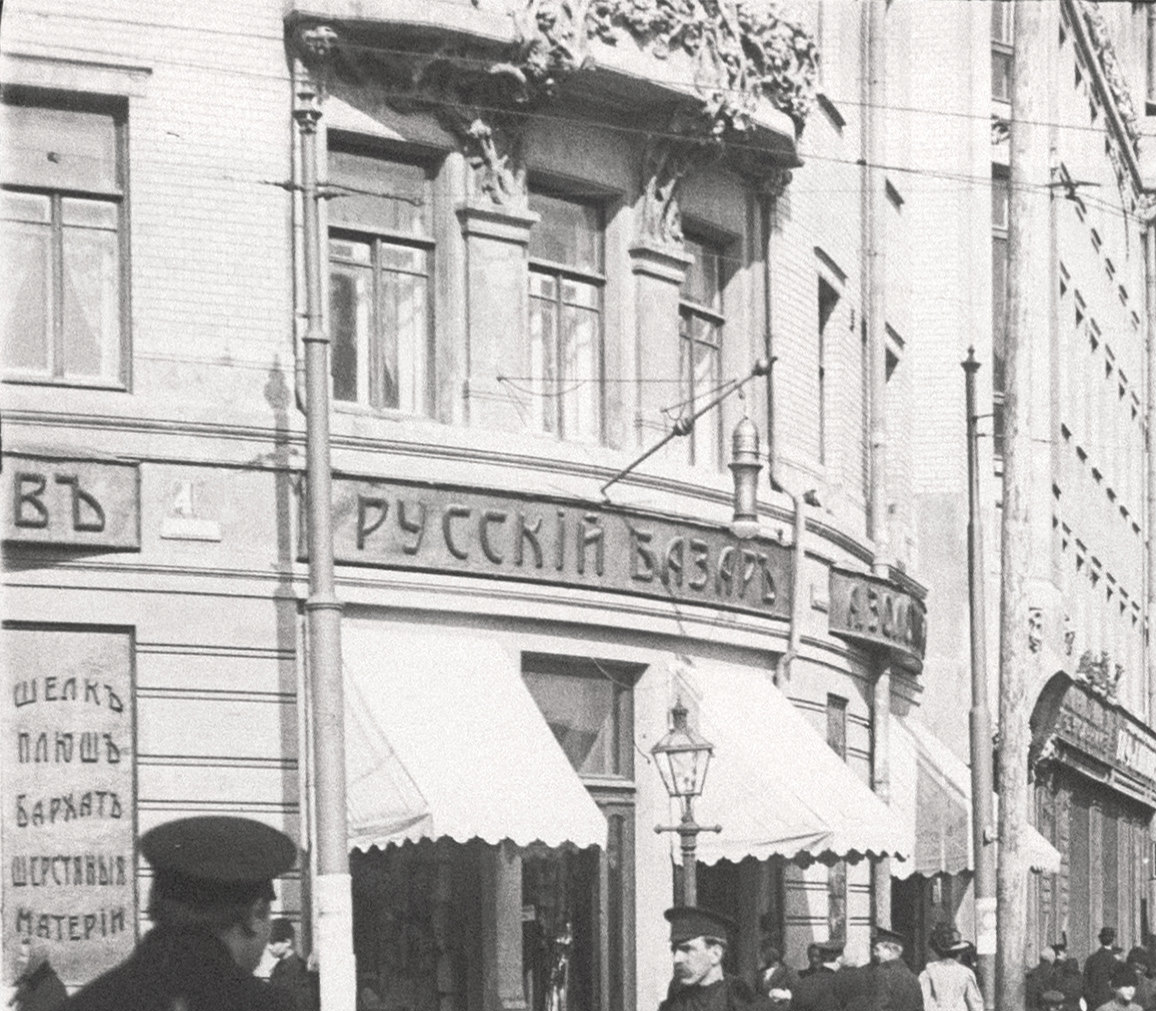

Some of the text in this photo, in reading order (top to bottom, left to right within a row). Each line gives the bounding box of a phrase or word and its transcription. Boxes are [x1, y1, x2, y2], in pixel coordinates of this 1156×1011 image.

[355, 495, 776, 605] РУССКІЙ БАЗАРЪ
[14, 676, 124, 713] ШЕЛКЪ
[17, 731, 121, 764] ПЛЮШЪ
[16, 791, 122, 828] БАРХАТЪ
[15, 907, 126, 941] МАТЕРІИ
